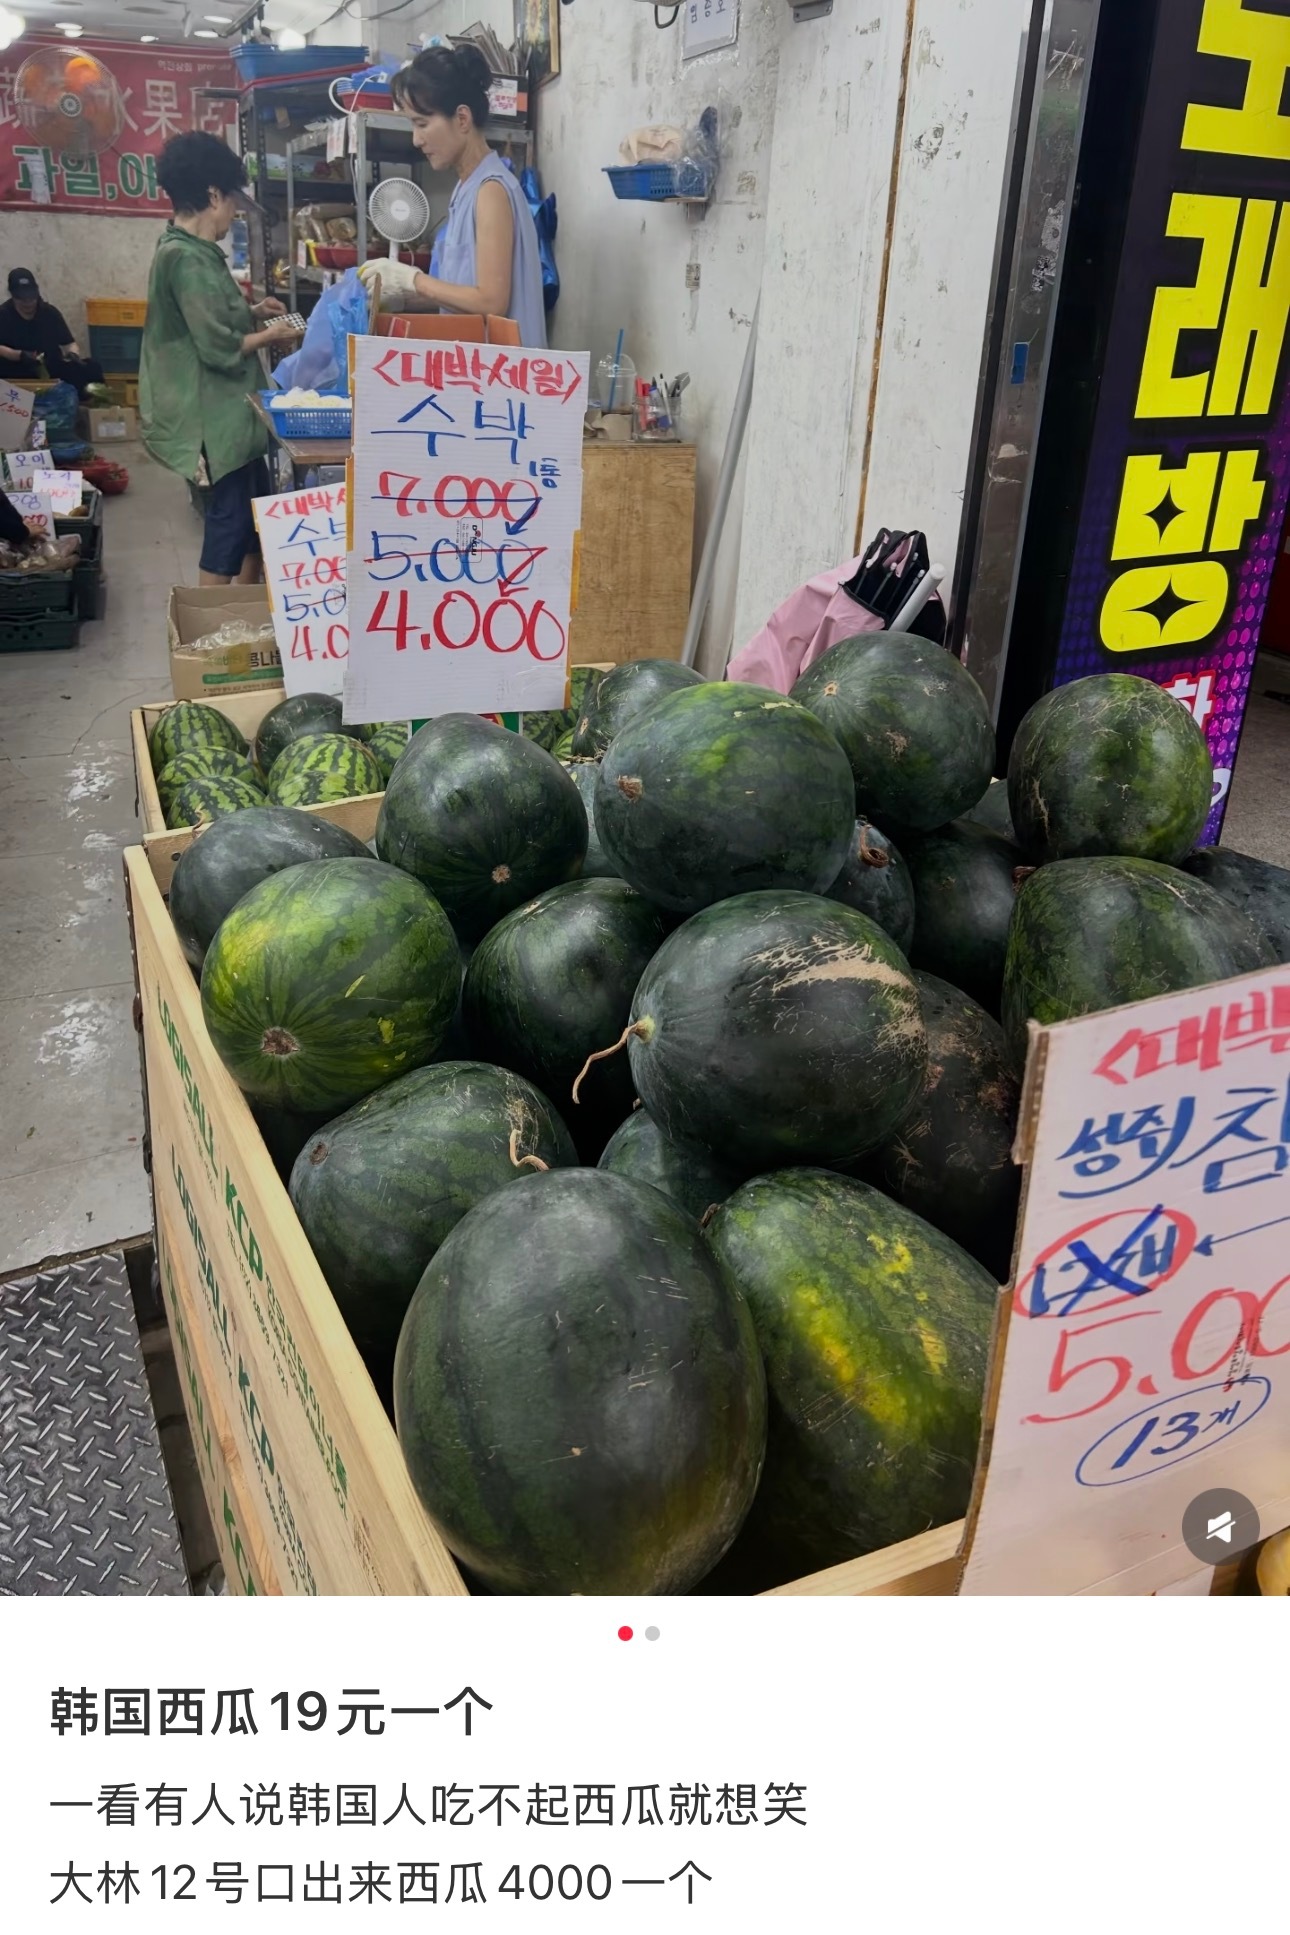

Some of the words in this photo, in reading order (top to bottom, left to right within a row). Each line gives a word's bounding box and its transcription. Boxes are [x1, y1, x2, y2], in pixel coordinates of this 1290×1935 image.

[16, 452, 46, 468] 오이
[371, 394, 535, 465] 수박
[379, 471, 541, 523] 7.000
[368, 531, 535, 587] 5.000
[366, 590, 566, 661] 4.000
[157, 980, 219, 1180] LOGISALL
[225, 1164, 263, 1281] KCP
[171, 1143, 232, 1356] LOGISALL
[238, 1353, 275, 1476] KCP
[1111, 1400, 1241, 1470] 13개
